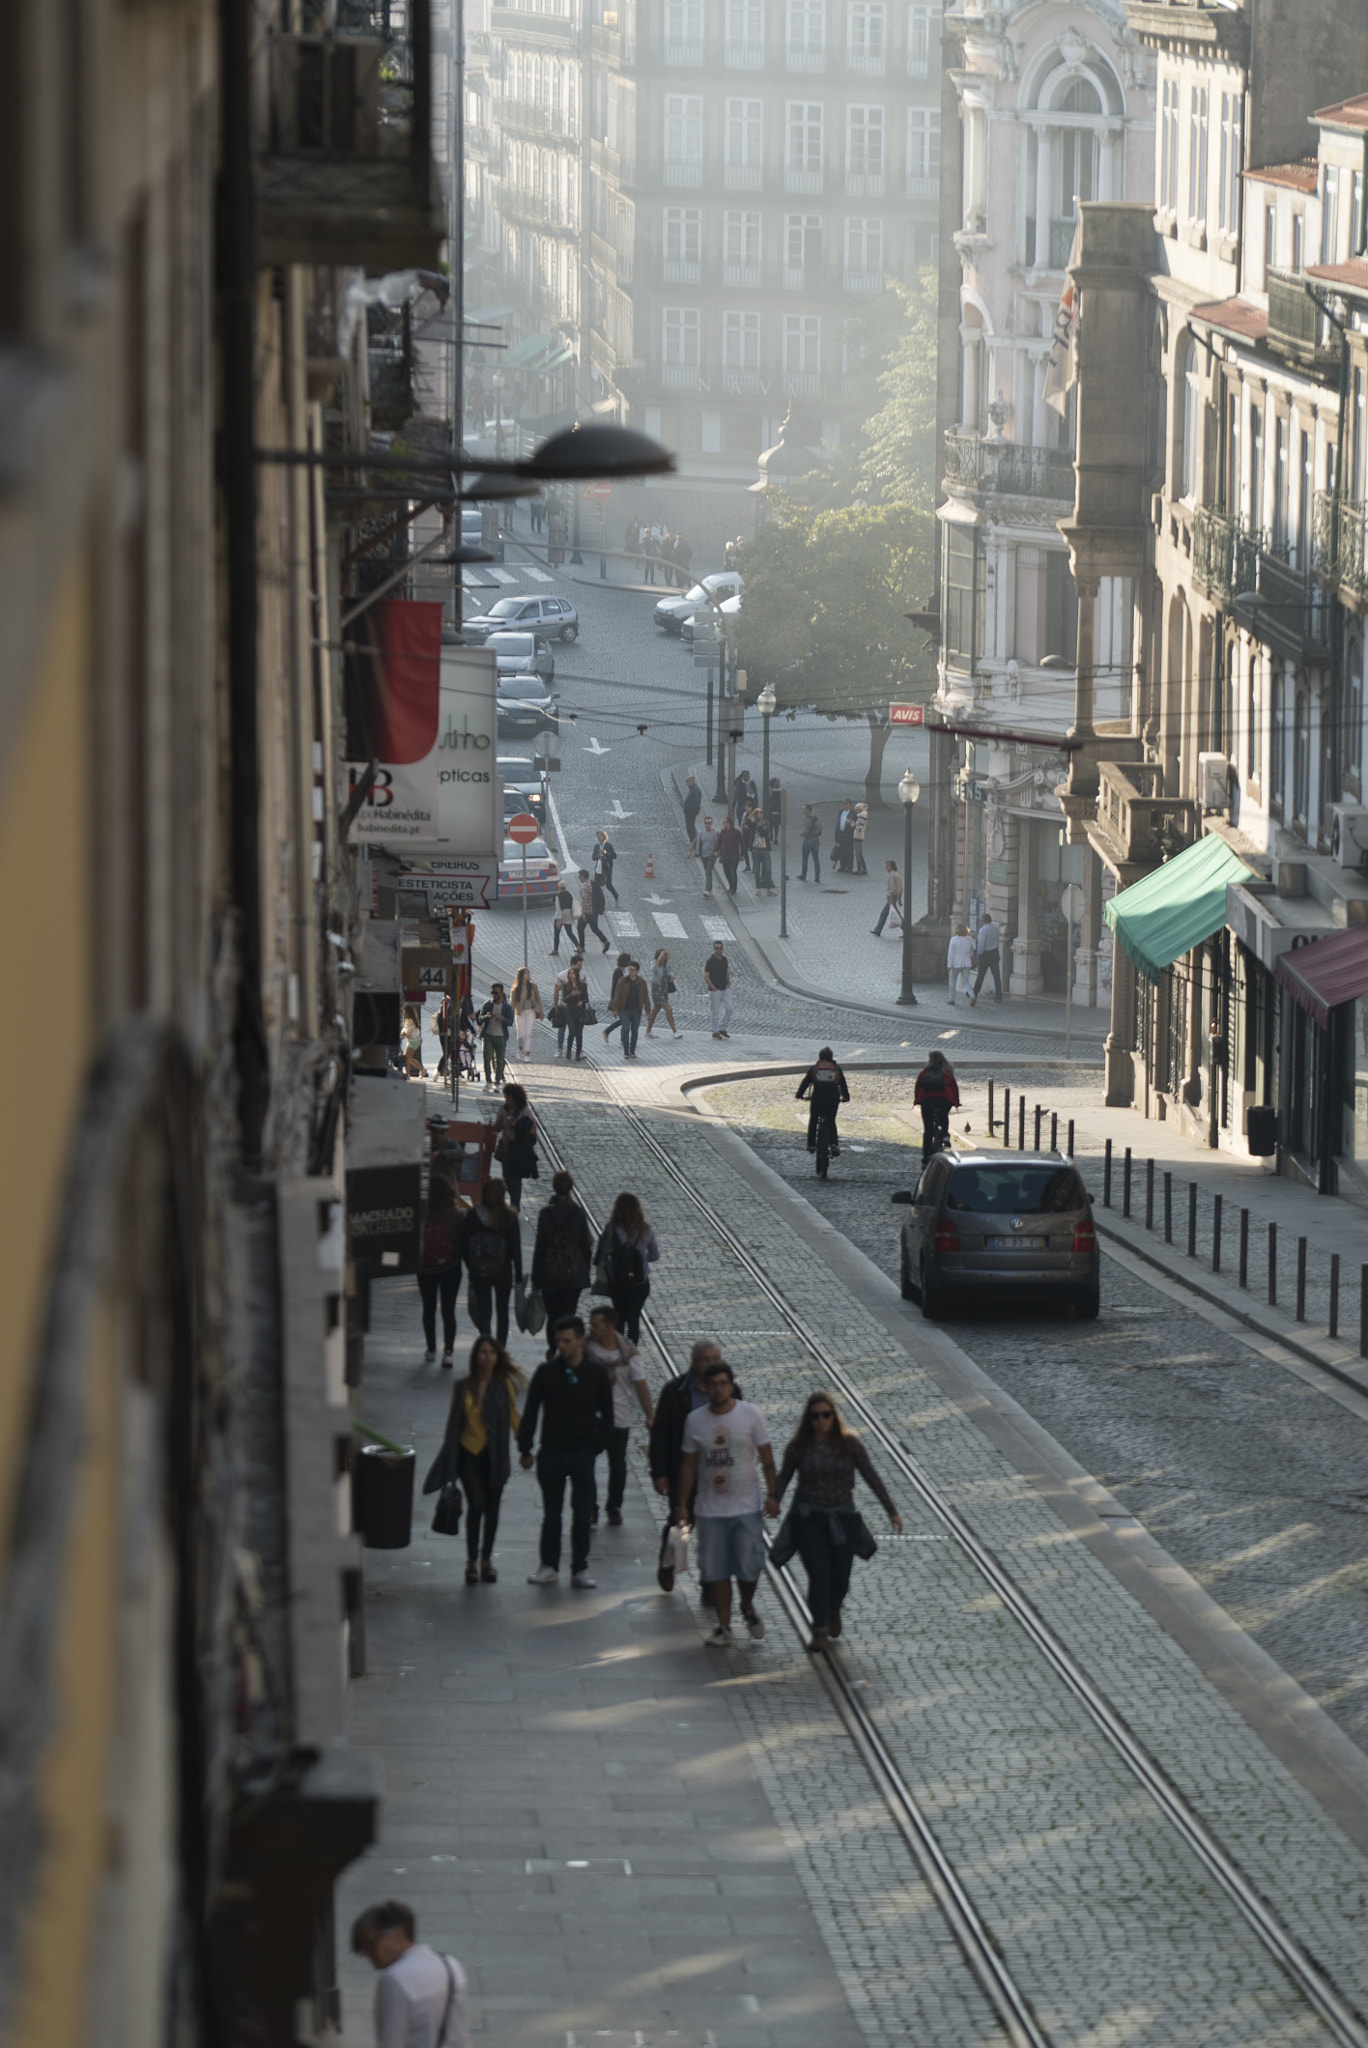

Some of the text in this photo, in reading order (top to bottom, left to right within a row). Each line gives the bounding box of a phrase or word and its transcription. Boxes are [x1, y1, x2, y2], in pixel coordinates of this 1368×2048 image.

[893, 709, 920, 721] AVIS
[438, 769, 490, 784] pticas
[399, 879, 473, 890] ESTETICISTA
[433, 890, 474, 904] AÇÕES
[348, 1206, 415, 1225] MACHADO
